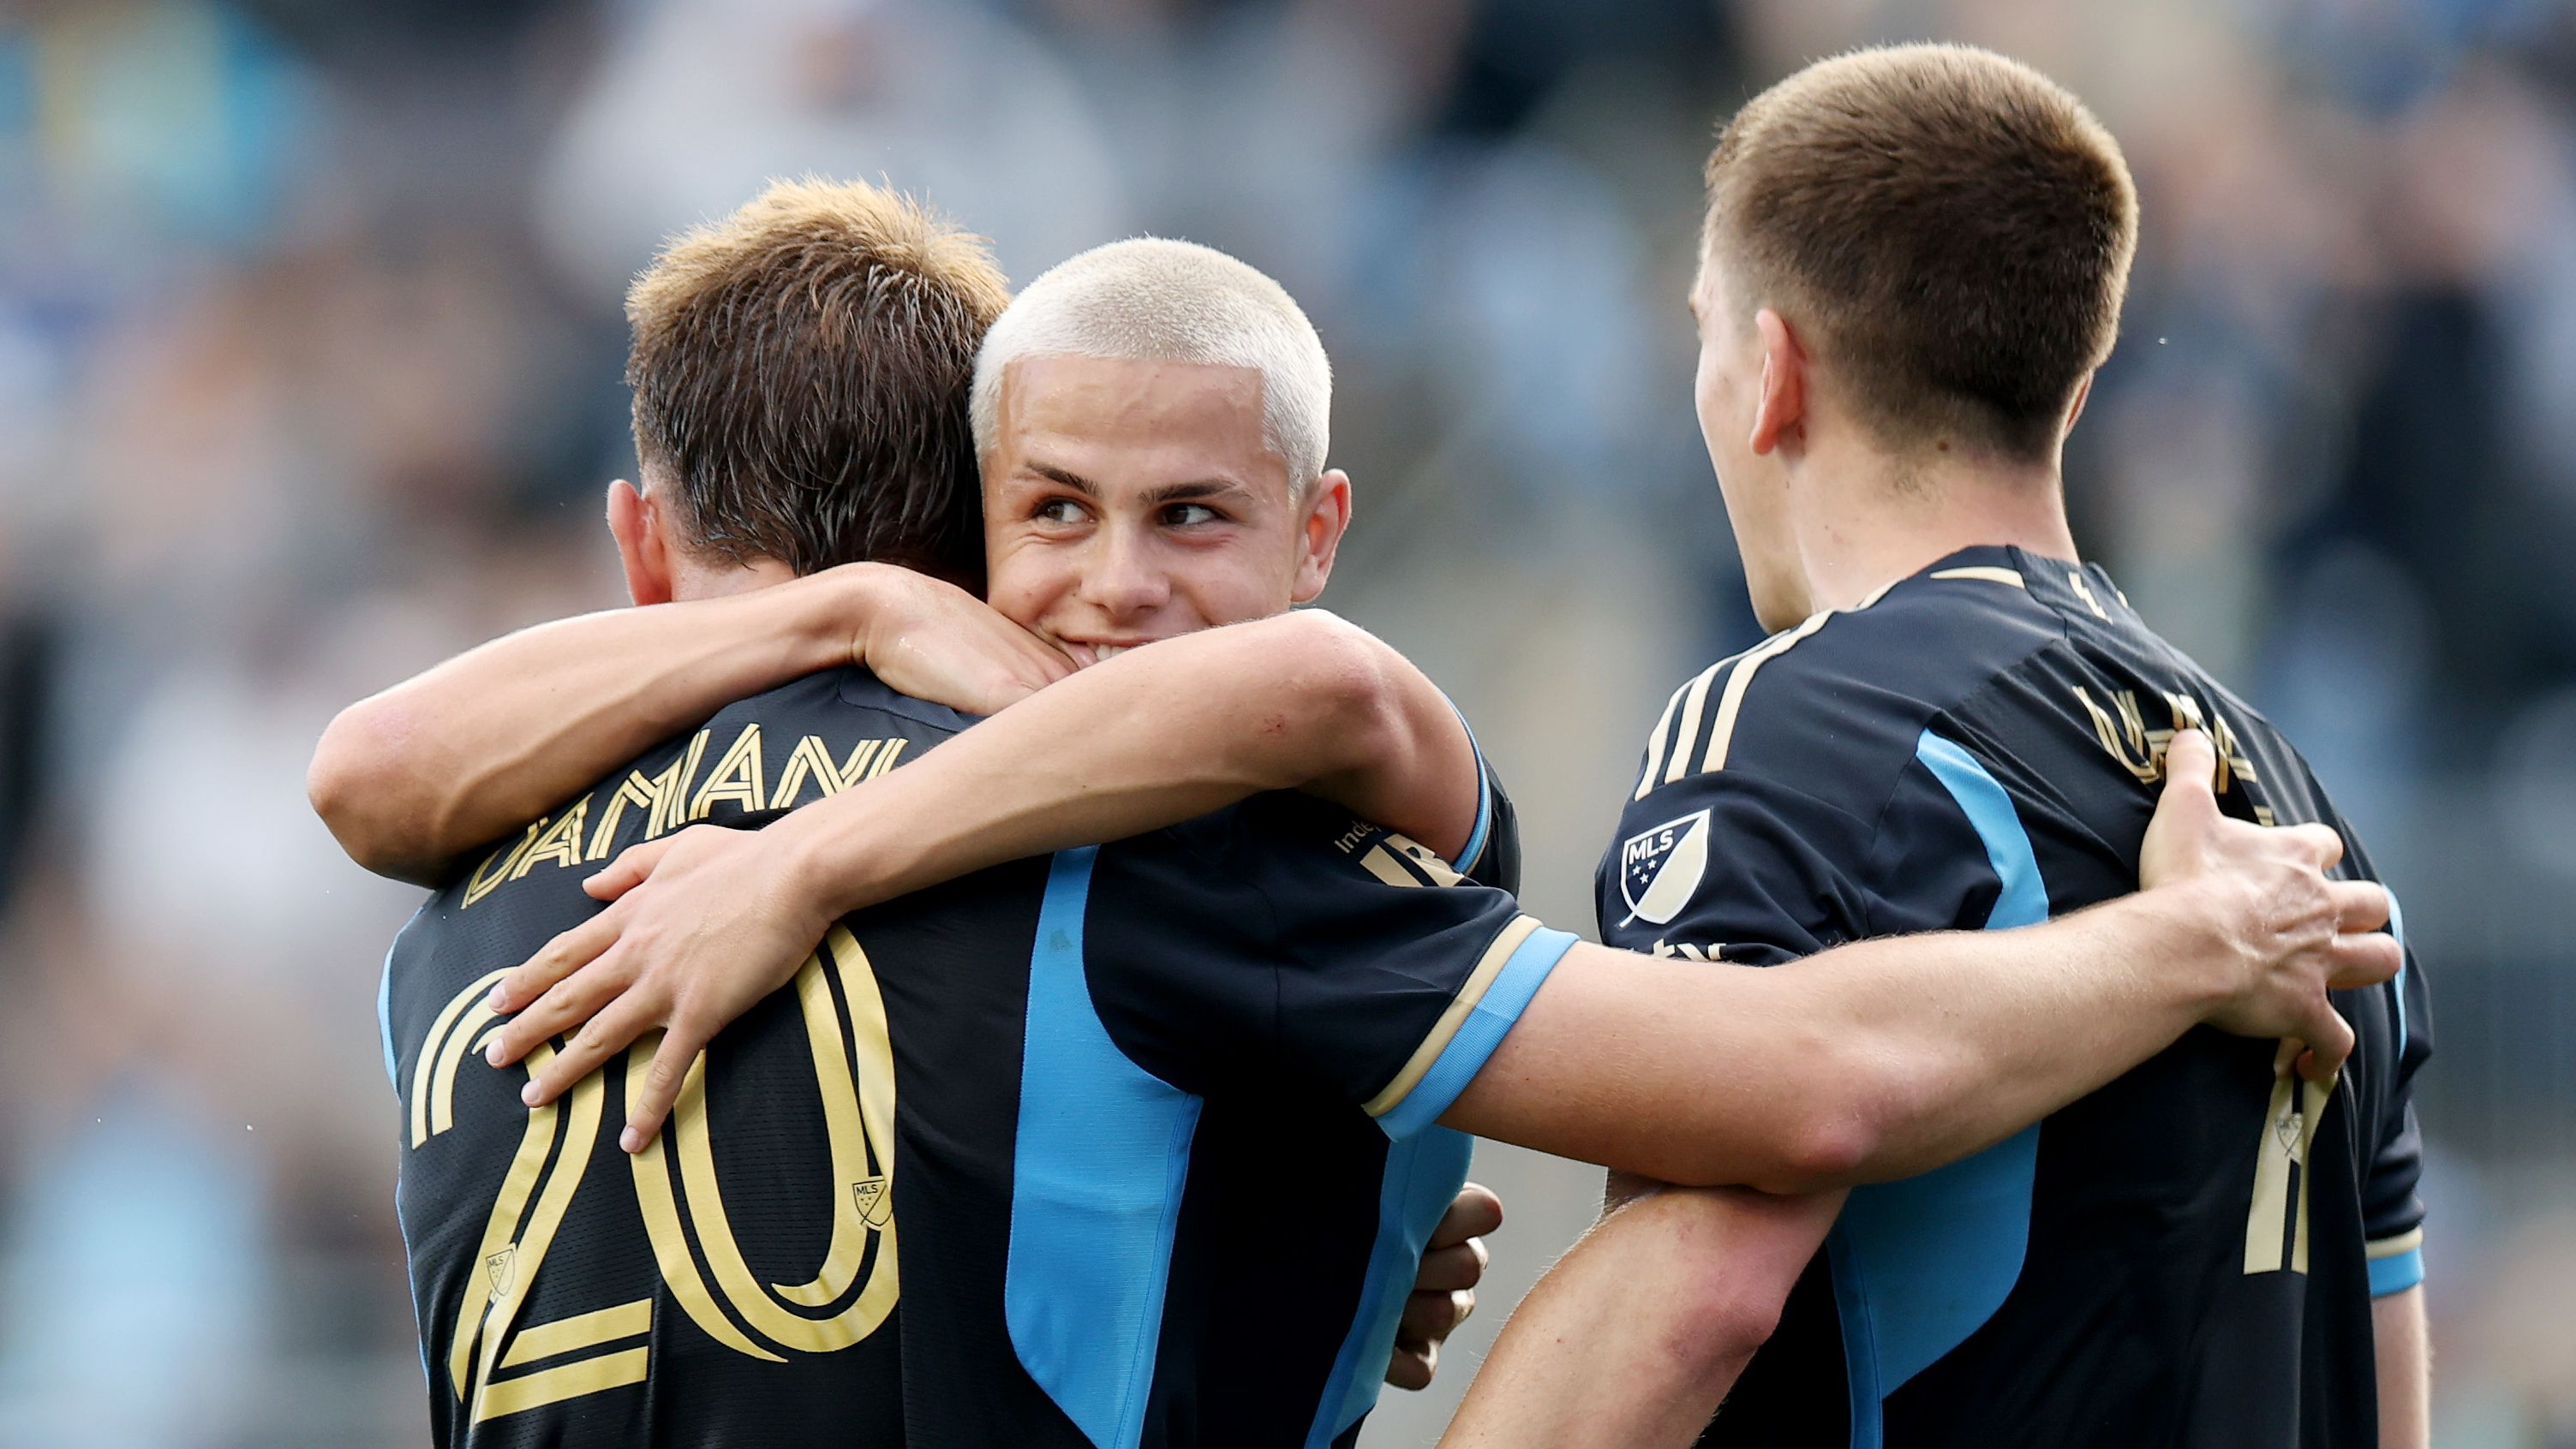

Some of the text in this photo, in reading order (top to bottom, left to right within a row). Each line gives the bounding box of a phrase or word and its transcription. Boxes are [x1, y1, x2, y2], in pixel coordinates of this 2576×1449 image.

[1334, 820, 1383, 854] Inde
[1629, 829, 1673, 864] MLS
[412, 921, 900, 1429] 20
[857, 1184, 878, 1196] MLS
